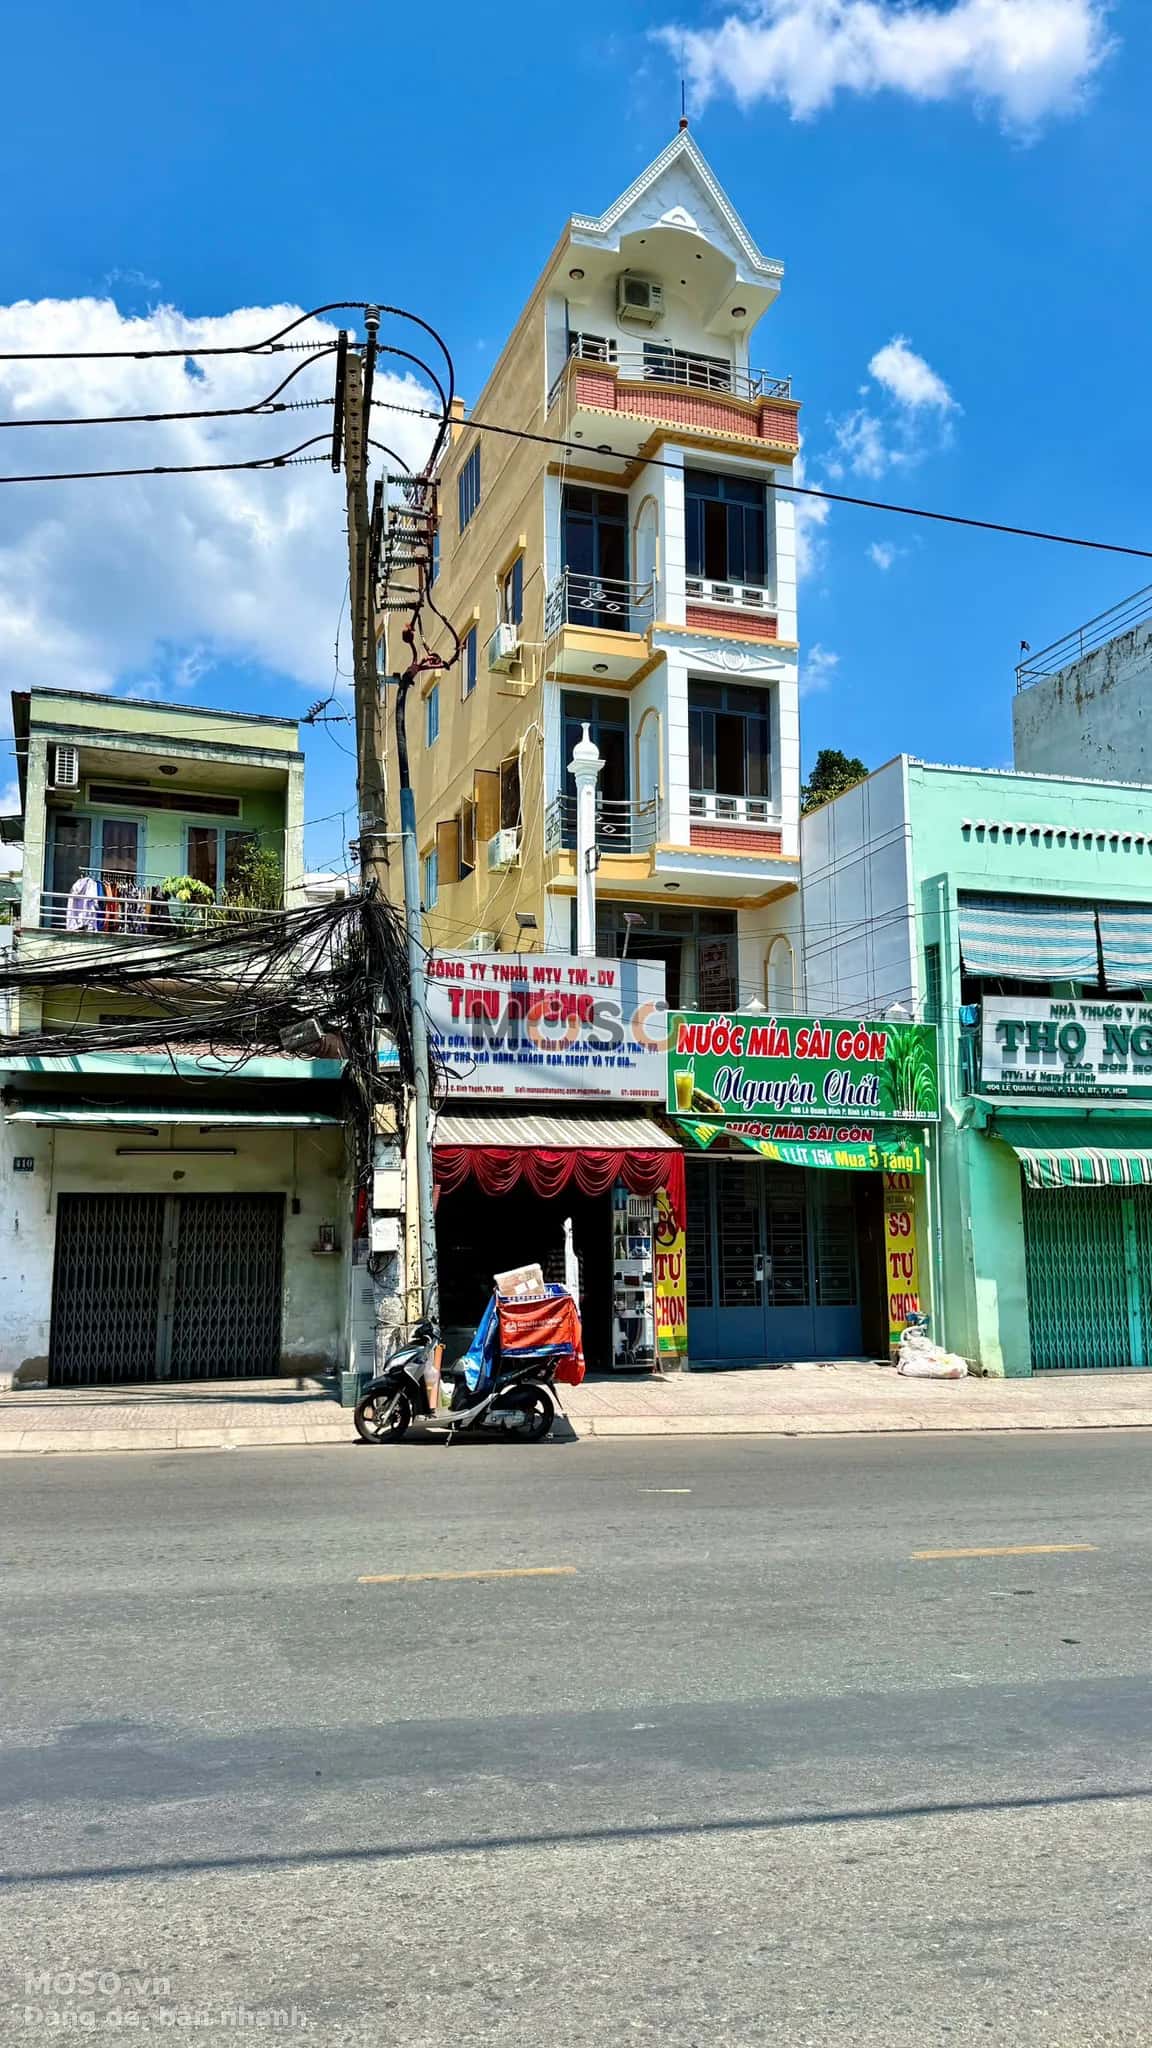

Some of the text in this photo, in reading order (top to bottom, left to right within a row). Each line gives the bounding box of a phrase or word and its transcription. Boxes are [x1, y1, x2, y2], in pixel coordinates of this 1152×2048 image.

[427, 959, 465, 978] CÔNG
[470, 963, 487, 980] TY
[493, 964, 528, 981] TNHH
[533, 966, 562, 984] MTV
[568, 968, 588, 984] TM
[448, 988, 501, 1019] THU
[1050, 1002, 1077, 1018] NHÀ
[1080, 1003, 1122, 1019] THUỐC
[1126, 1007, 1136, 1019] Y
[677, 1017, 887, 1061] NƯỚC MÍA SÀI GÒN
[996, 1019, 1087, 1063] THỌ
[713, 1066, 880, 1110] Nguyên Chất
[834, 1150, 867, 1167] Mua
[868, 1144, 878, 1168] 5
[913, 1146, 921, 1170] 1
[656, 1249, 683, 1289] TỰ
